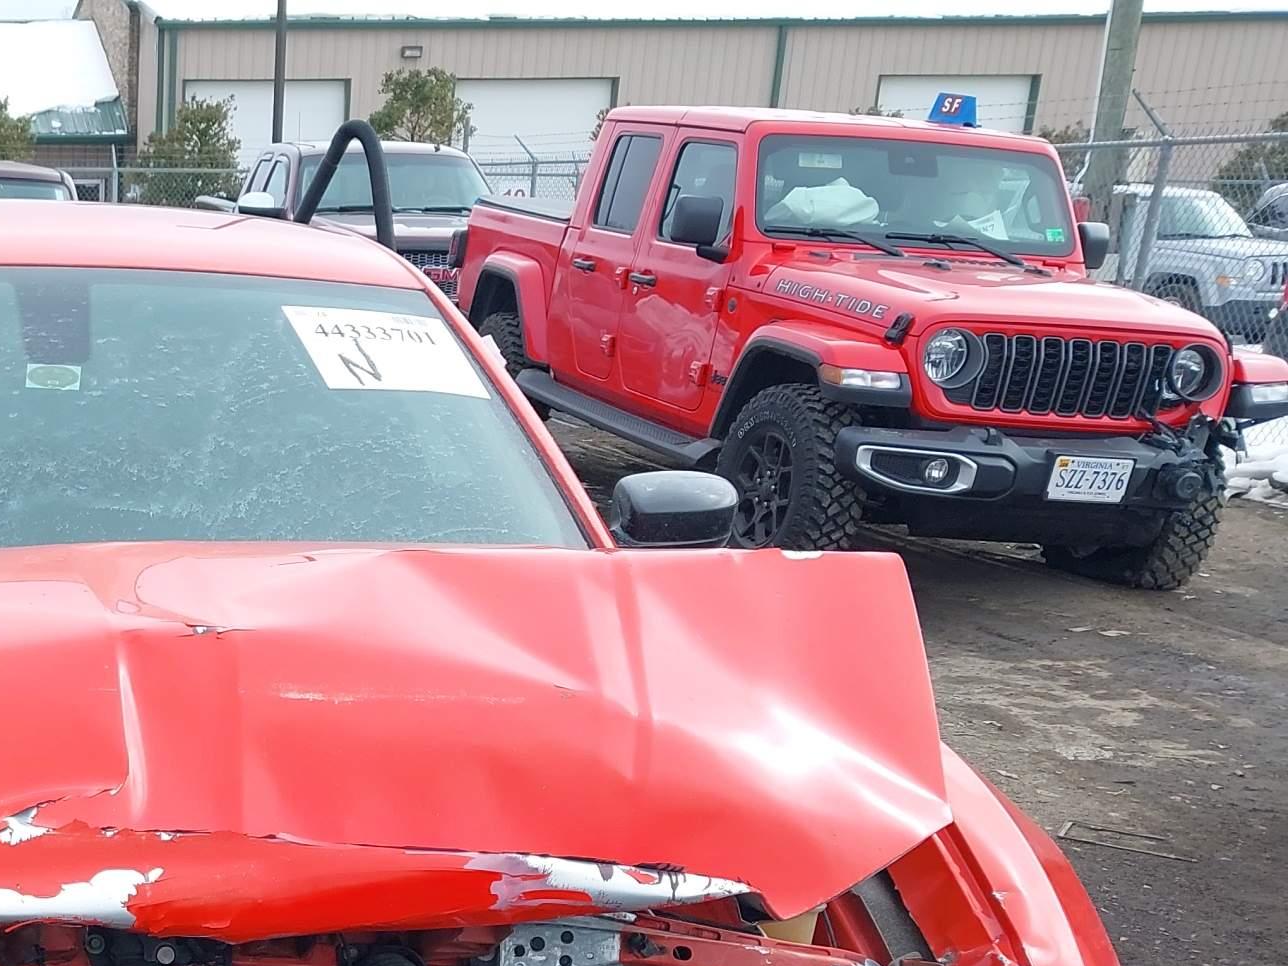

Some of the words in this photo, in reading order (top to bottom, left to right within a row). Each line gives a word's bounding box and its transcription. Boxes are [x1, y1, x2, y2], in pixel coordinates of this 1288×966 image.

[941, 97, 962, 113] SF
[423, 267, 461, 282] GM
[776, 278, 828, 303] HIGH
[835, 294, 889, 319] TIDE
[314, 323, 437, 345] 44333701
[338, 338, 382, 386] N
[1077, 461, 1113, 470] VIRGINIA
[1055, 468, 1128, 491] SZZ-7376
